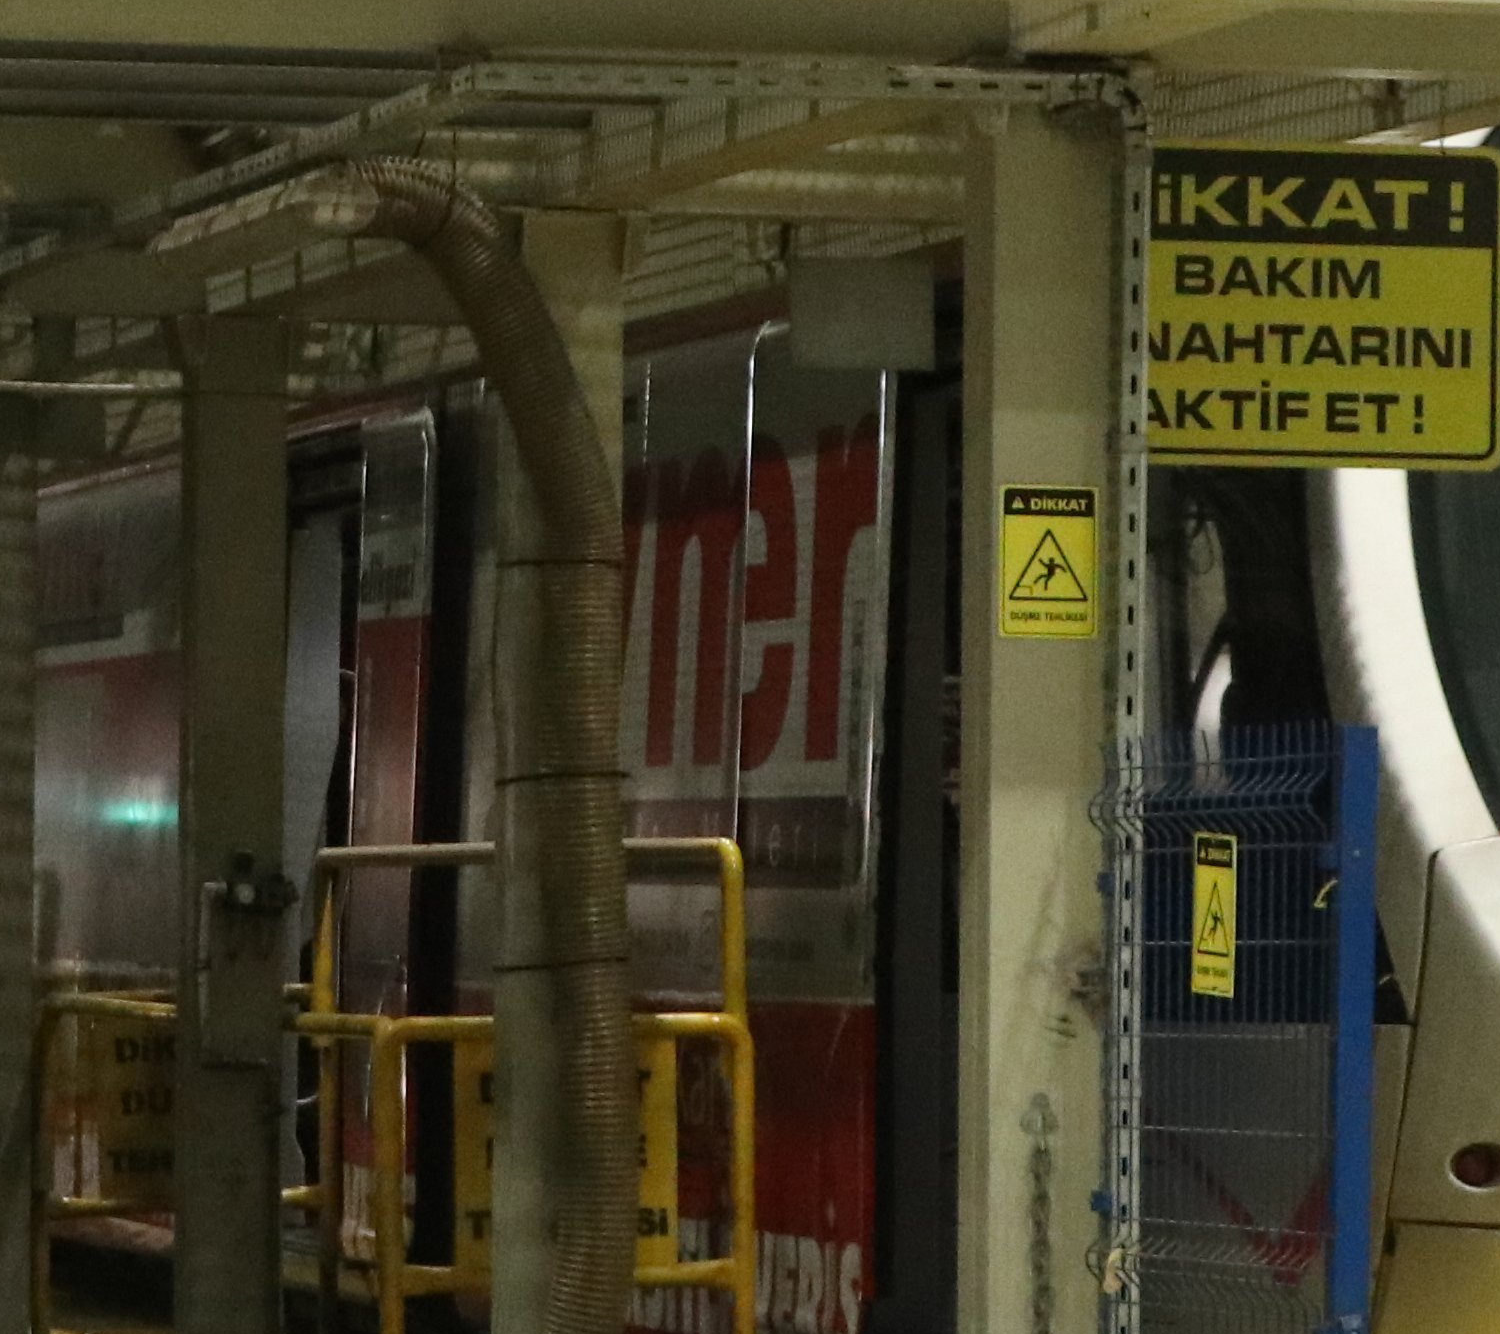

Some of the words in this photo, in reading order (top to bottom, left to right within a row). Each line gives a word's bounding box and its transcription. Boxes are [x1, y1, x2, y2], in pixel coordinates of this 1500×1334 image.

[1173, 253, 1382, 300] BAKIM
[1325, 392, 1400, 435] ET
[1031, 495, 1088, 512] DİKKAT
